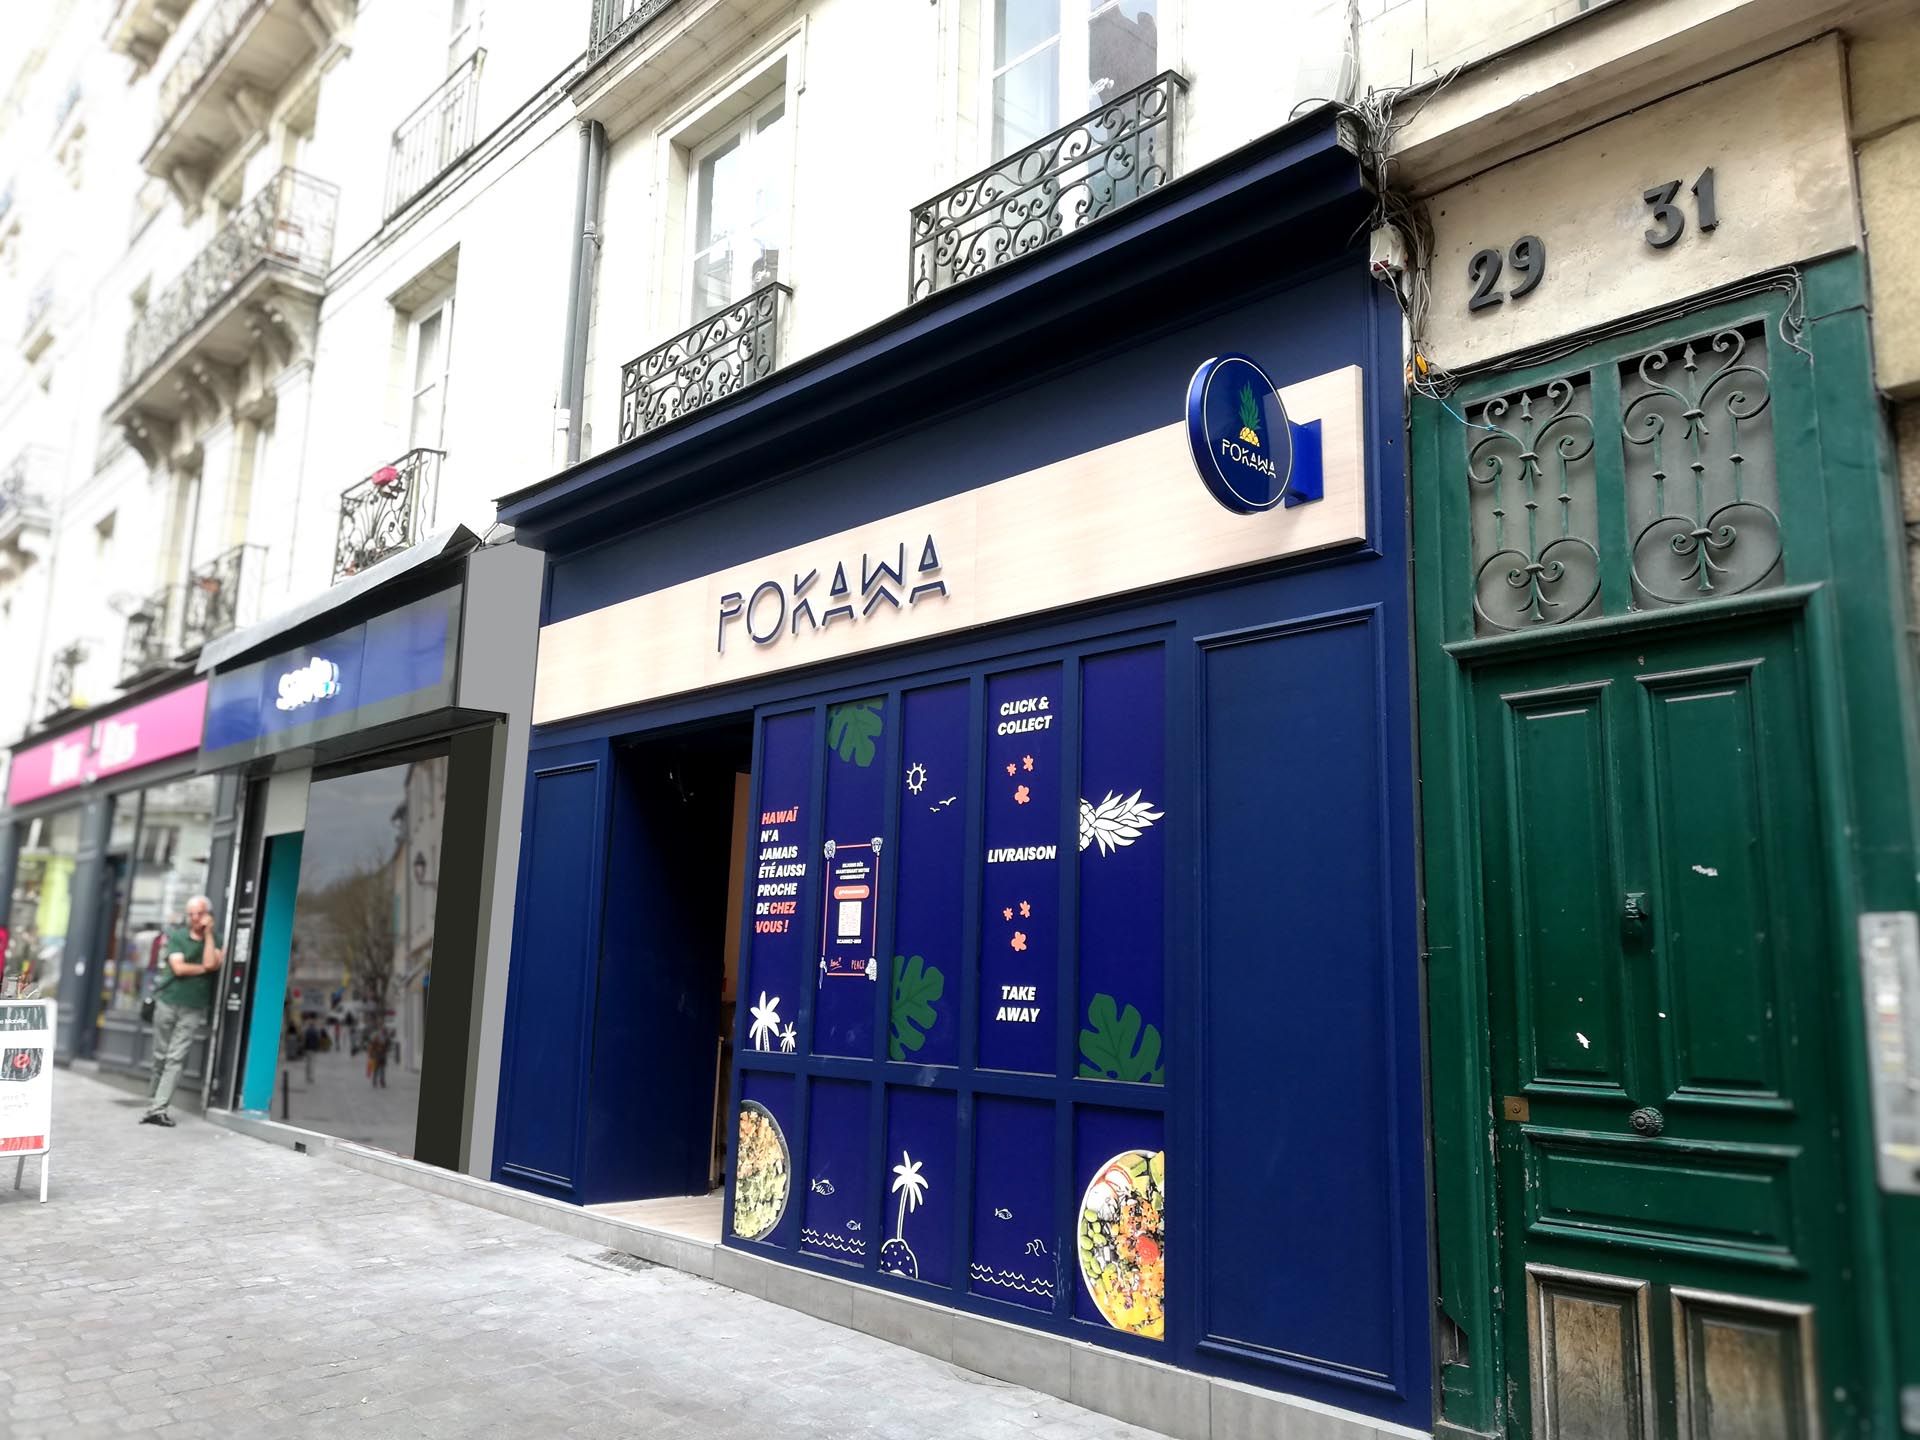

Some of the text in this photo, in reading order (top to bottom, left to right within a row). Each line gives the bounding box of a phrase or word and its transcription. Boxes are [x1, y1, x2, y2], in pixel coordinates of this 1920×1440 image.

[1644, 166, 1719, 249] 31
[1468, 235, 1546, 312] 29
[1222, 438, 1277, 479] POKAWA
[718, 534, 947, 653] POKAWA
[1000, 696, 1050, 716] CLICK &
[997, 715, 1053, 736] COLLECT
[761, 806, 799, 825] HAWAÏ
[759, 846, 798, 861] JAMAIS
[987, 845, 1057, 863] LIVRAISON
[758, 862, 806, 878] ÉTÉ AUSSI
[757, 882, 797, 897] PROCHE
[756, 901, 797, 915] DE CHEZ
[755, 920, 783, 933] VOUS
[1002, 986, 1036, 1001] TAKE
[996, 1006, 1040, 1022] AWAY
